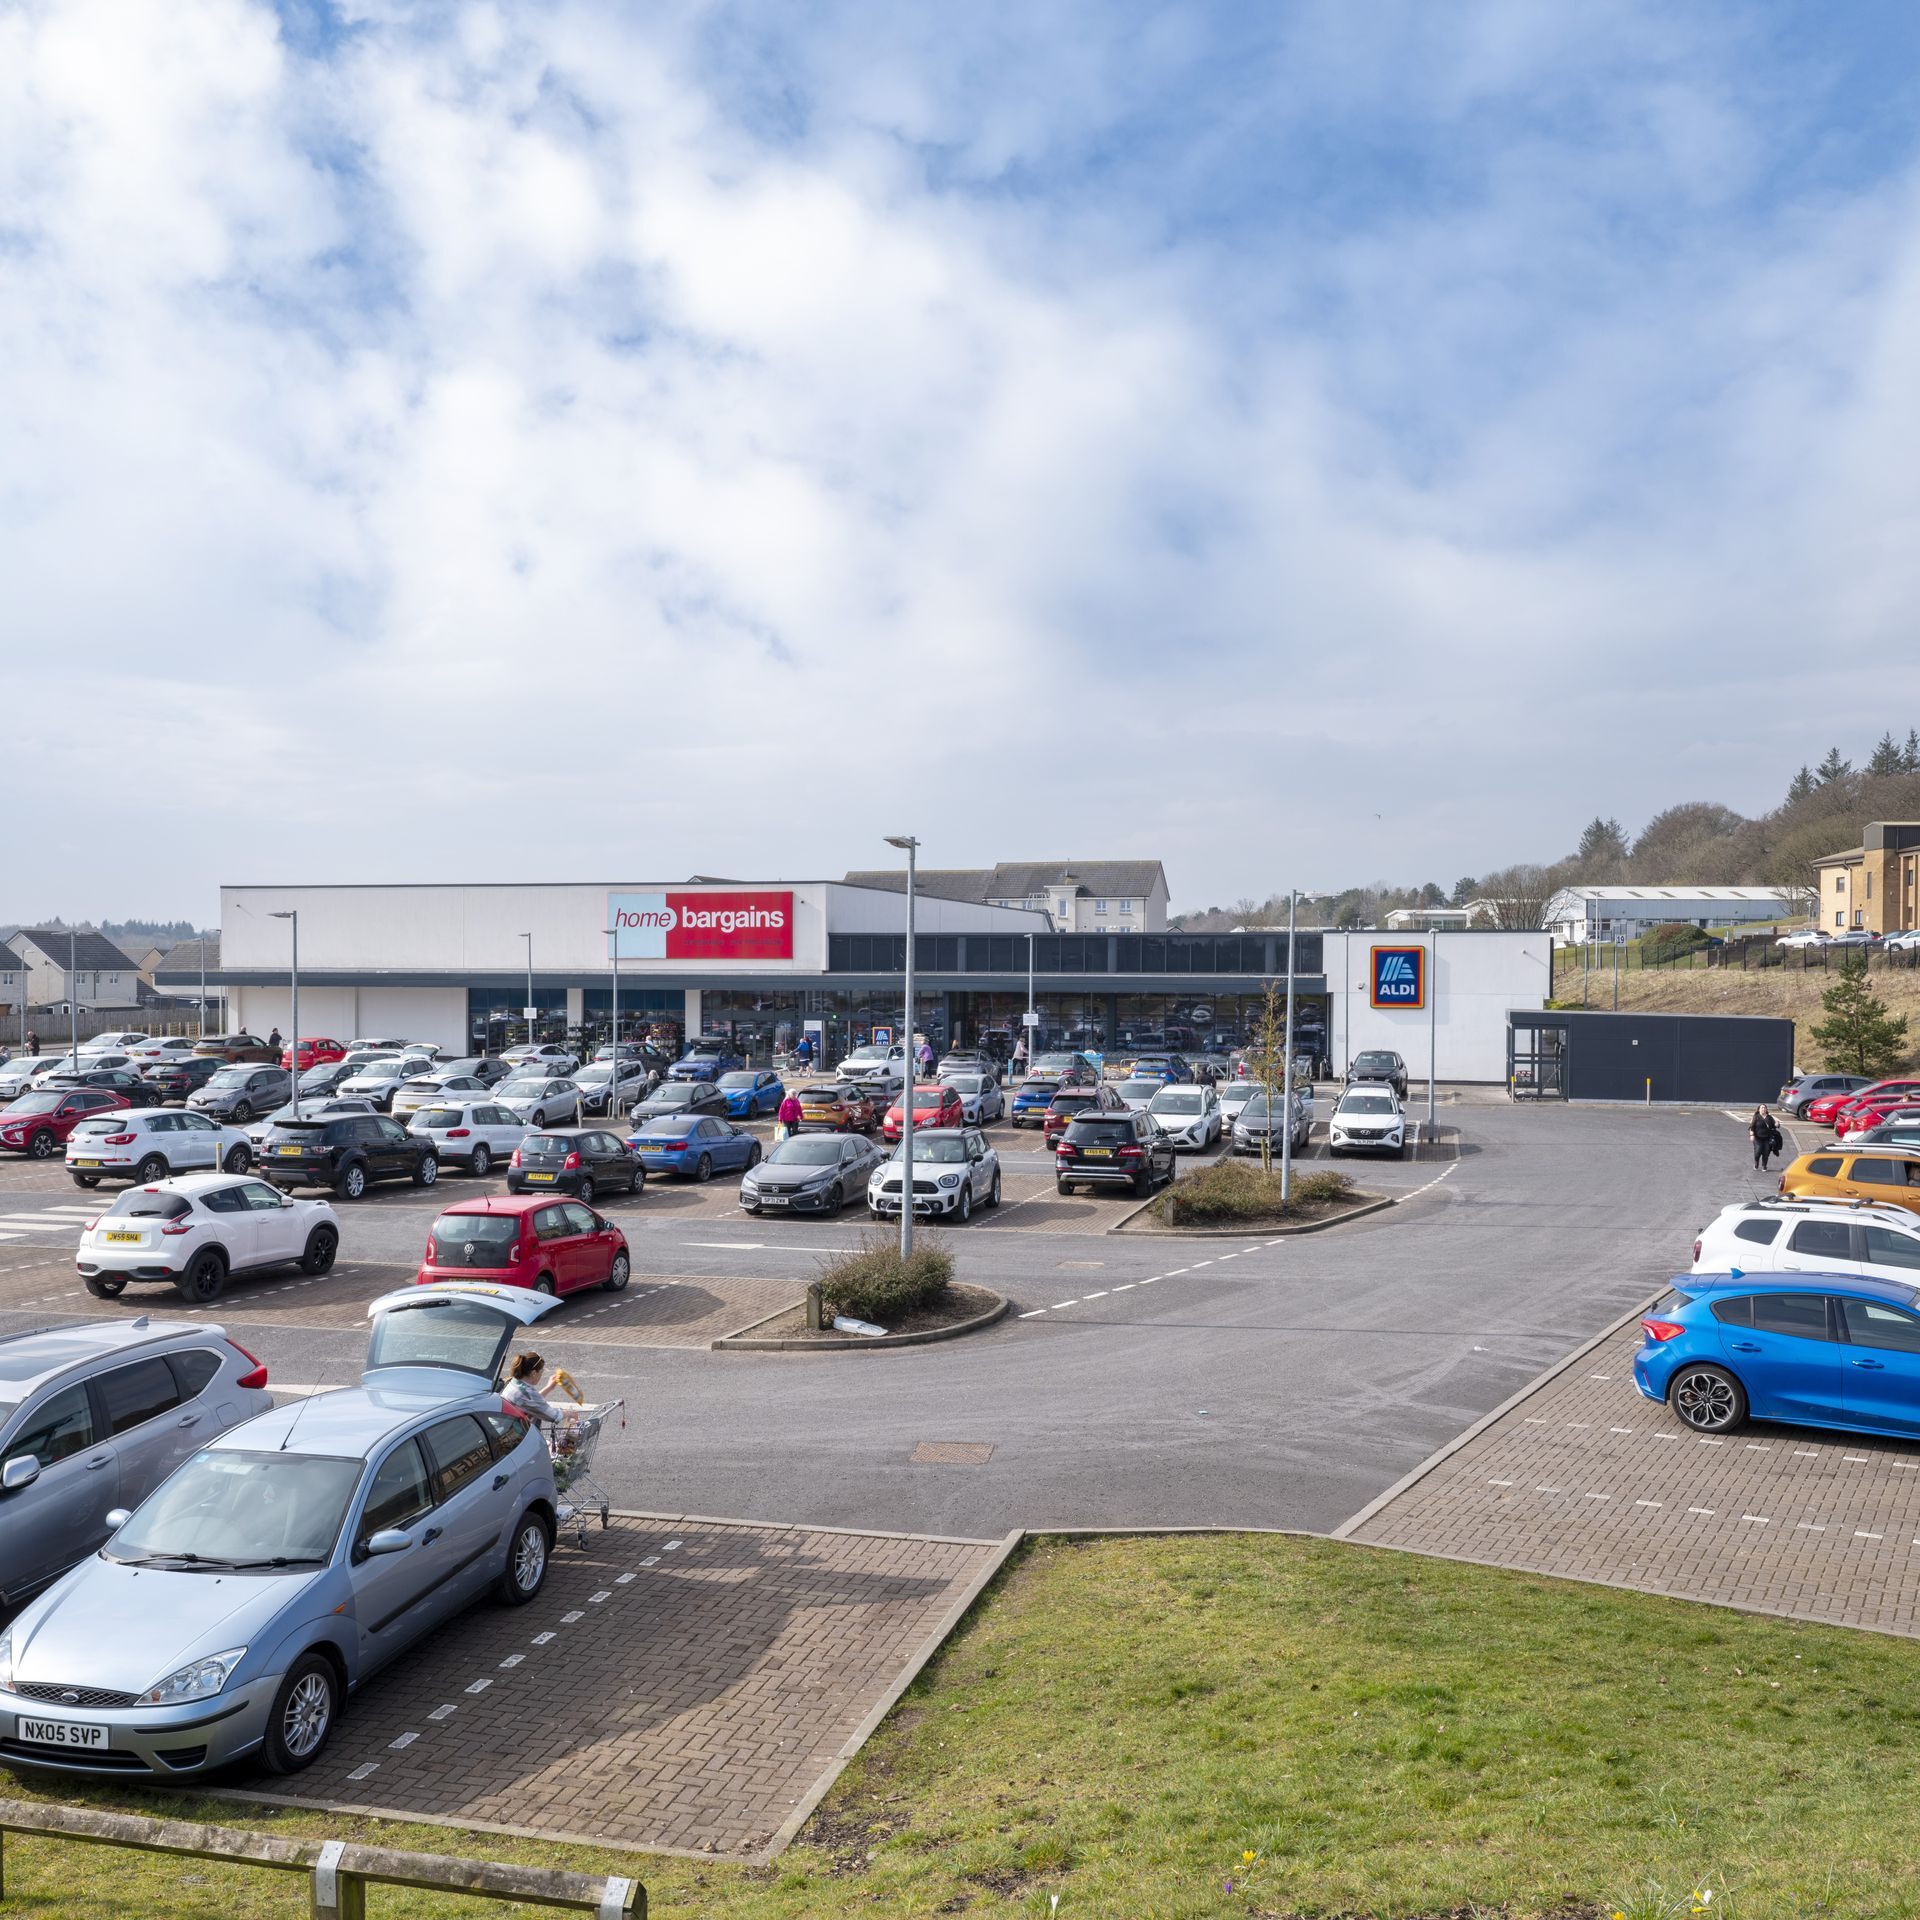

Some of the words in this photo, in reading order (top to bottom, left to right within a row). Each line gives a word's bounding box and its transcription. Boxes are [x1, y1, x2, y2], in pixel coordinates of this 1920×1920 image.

[615, 907, 671, 928] home
[682, 905, 784, 933] bargains
[1616, 935, 1625, 944] 19
[1379, 984, 1415, 995] ALDI
[25, 1721, 65, 1742] NX05
[70, 1727, 101, 1745] SVP
